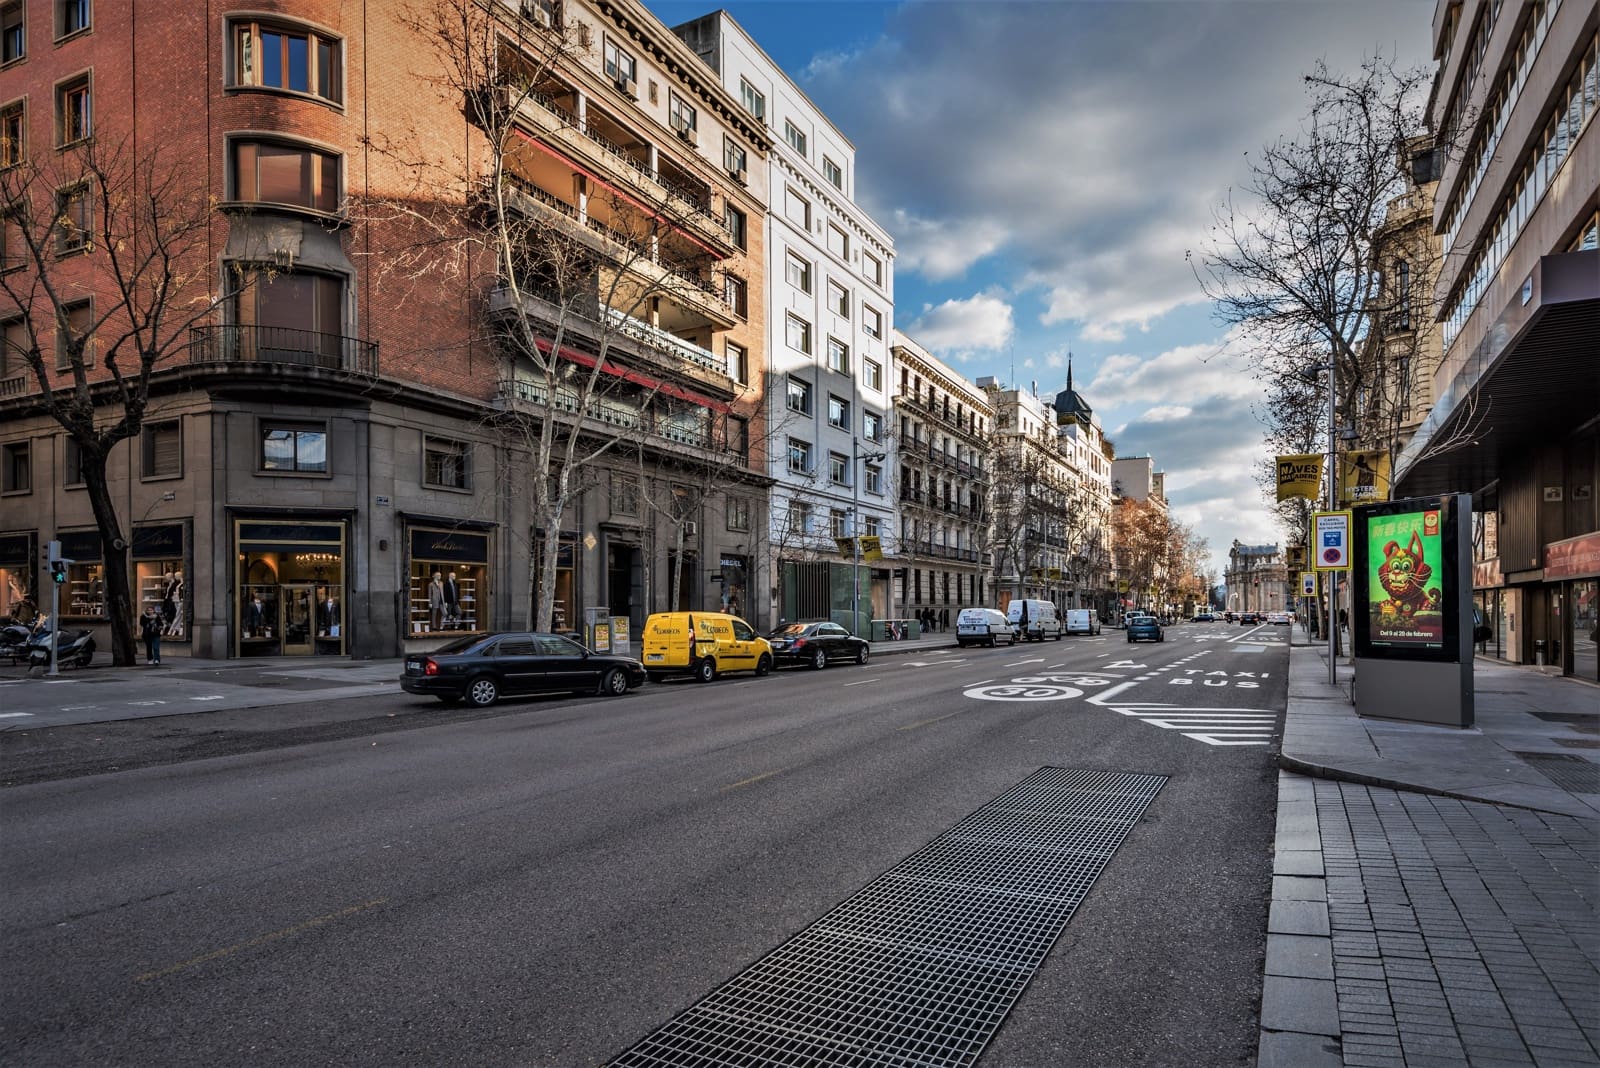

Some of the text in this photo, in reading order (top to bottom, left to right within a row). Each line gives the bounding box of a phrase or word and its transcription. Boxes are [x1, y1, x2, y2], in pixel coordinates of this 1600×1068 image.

[1280, 464, 1318, 475] NAVES
[720, 559, 742, 567] DIESEL
[707, 625, 729, 634] CORREOS
[1184, 669, 1270, 678] TAXI
[1168, 678, 1260, 688] BUS
[990, 687, 1058, 697] 30
